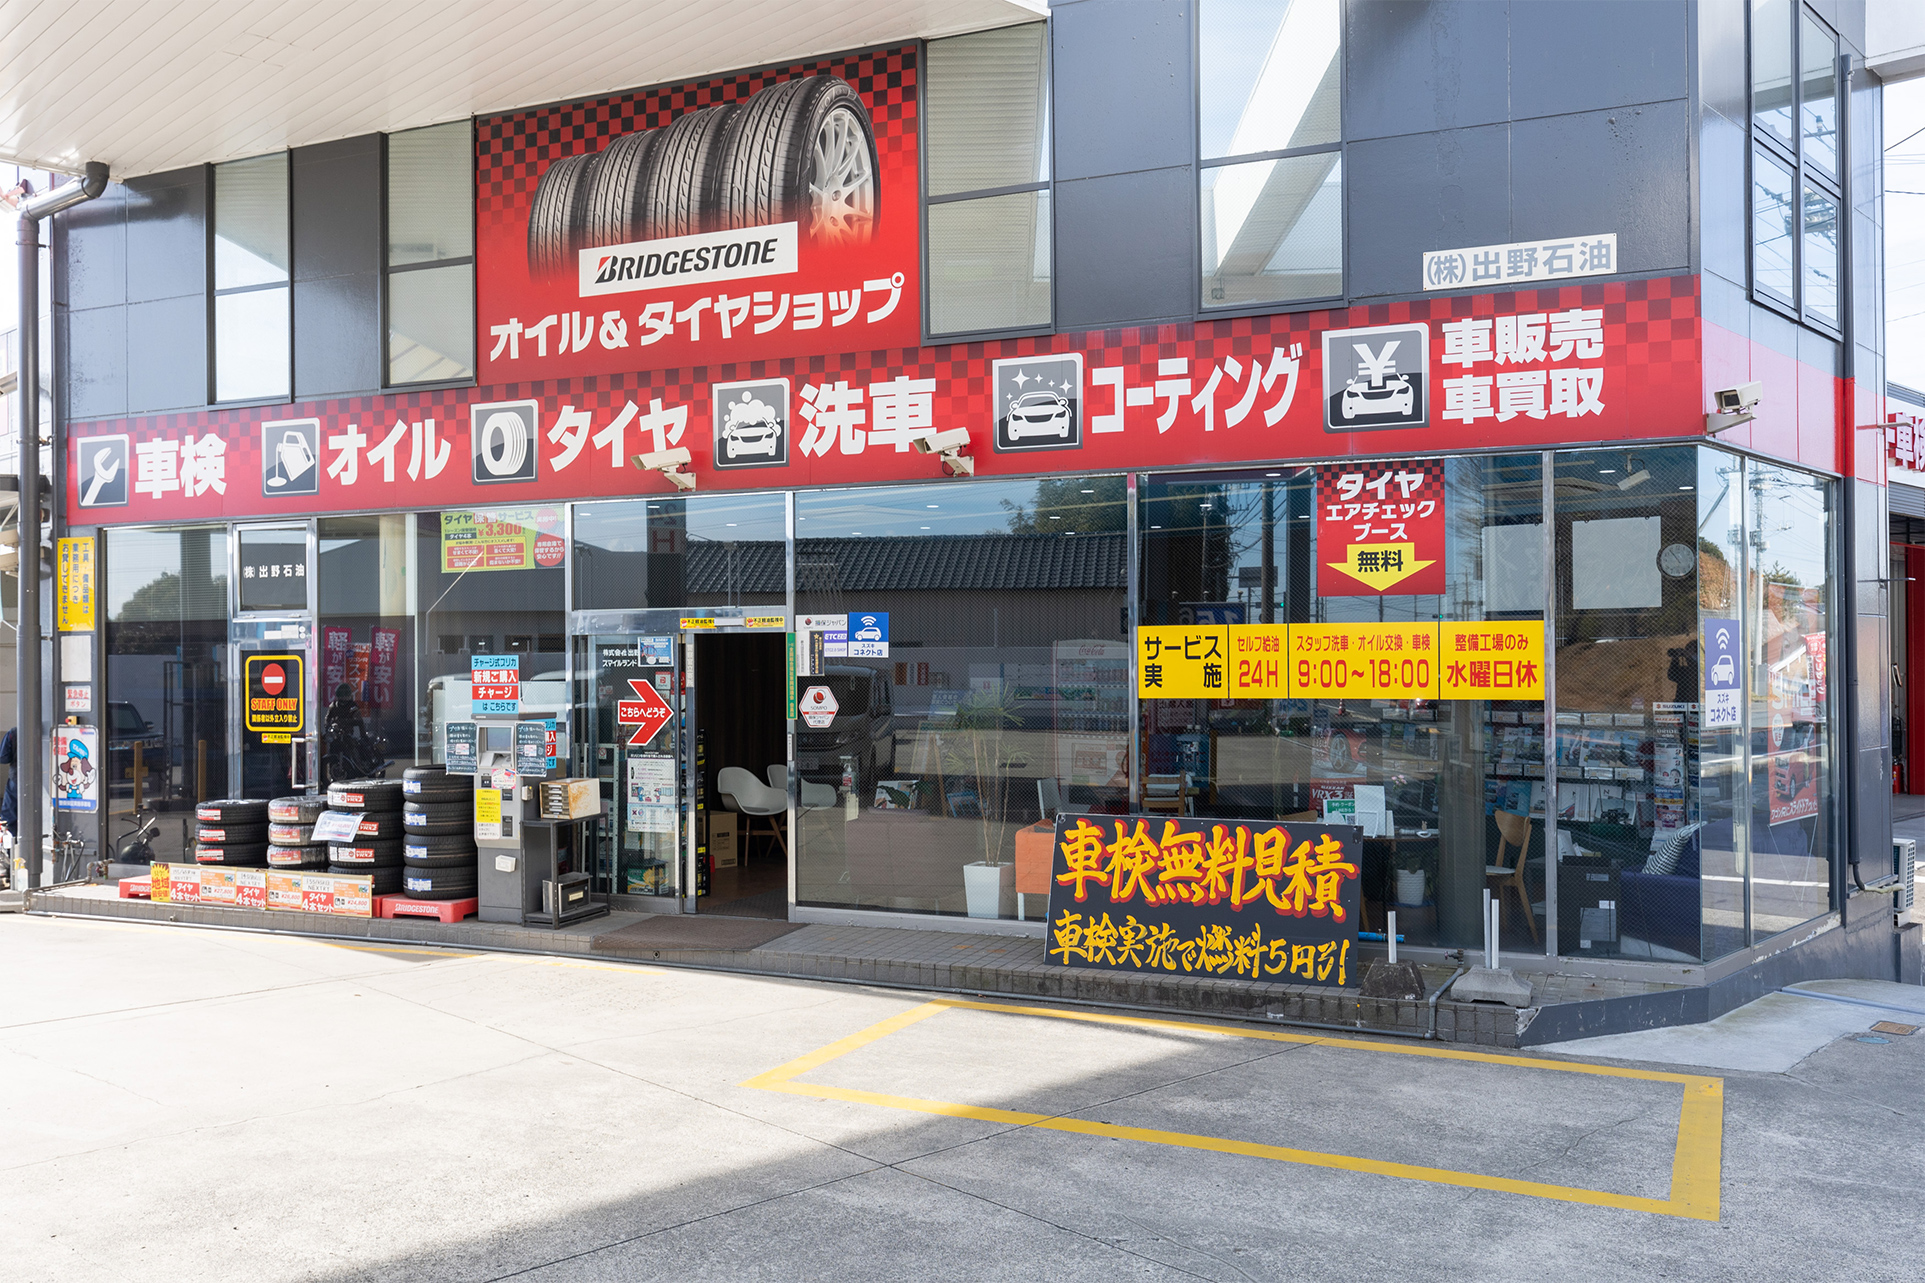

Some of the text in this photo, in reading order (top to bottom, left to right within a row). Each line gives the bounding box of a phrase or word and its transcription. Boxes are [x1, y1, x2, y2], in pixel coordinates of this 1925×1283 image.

[594, 237, 778, 284] BRIDGESTONE
[490, 271, 905, 362] オイル& タイヤショップ
[1441, 308, 1604, 368] 車販売
[1091, 342, 1303, 435] コーティング
[1441, 367, 1605, 424] 車買取
[797, 375, 937, 458] 洗車
[546, 397, 688, 472] タイヤ
[327, 417, 452, 486] オイル
[134, 432, 228, 499] 車検
[1336, 471, 1425, 501] タイヤ
[1325, 500, 1435, 522] エアチェック
[478, 522, 522, 537] ¥3,300
[1353, 522, 1408, 541] ブース
[1357, 549, 1404, 573] 無料
[61, 543, 69, 625] お貸しできません
[1144, 634, 1222, 661] サービス
[1236, 635, 1280, 653] セルフ給油
[1454, 634, 1529, 652] 整備工場のみ
[374, 632, 396, 703] 軽が安い
[602, 659, 638, 667] スマイルランド
[473, 669, 517, 683] 新規ご購入
[1238, 659, 1279, 688] 24H
[1446, 660, 1538, 689] 水曜日休
[477, 686, 513, 698] チャージ
[70, 700, 86, 708] ボタン
[251, 698, 297, 711] STAFF ONLY
[620, 707, 666, 719] こちらへどうぞ
[1710, 706, 1736, 722] コネクト店
[1056, 818, 1360, 923] 車検無料見積
[152, 877, 169, 889] 地域
[176, 883, 194, 891] タイヤ
[243, 887, 260, 897] タイヤ
[170, 888, 201, 902] 4本セット
[236, 893, 266, 907] 4本セット
[309, 892, 327, 902] タイヤ
[302, 898, 334, 912] 4本セット
[394, 903, 439, 914] BRIDGESTONE
